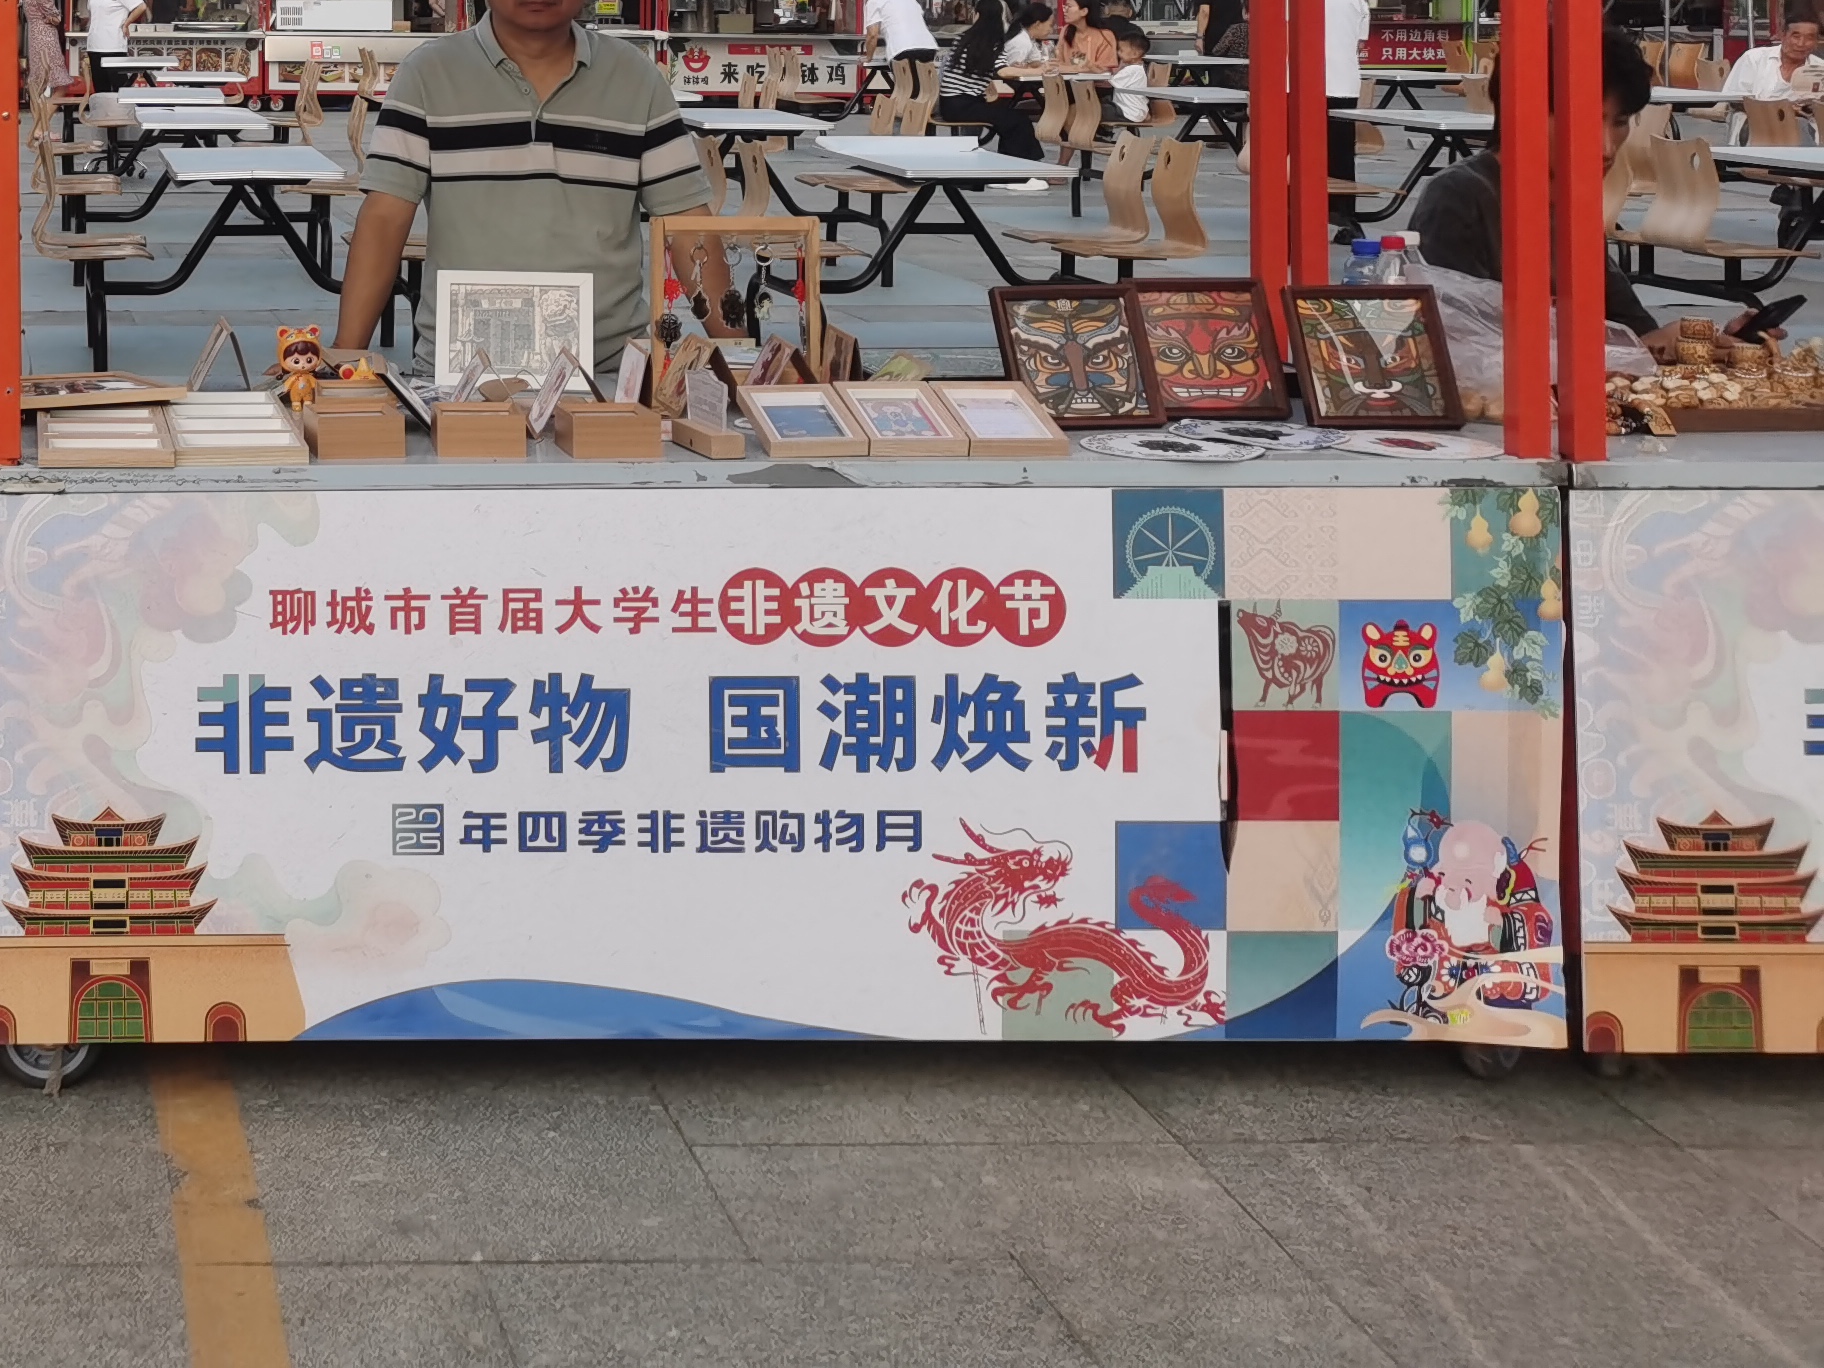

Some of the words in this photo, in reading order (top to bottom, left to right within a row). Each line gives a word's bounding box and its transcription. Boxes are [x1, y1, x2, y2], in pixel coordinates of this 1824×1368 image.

[1380, 29, 1450, 43] 不用边角料
[720, 62, 846, 86] 来吃钵鸡
[194, 672, 632, 775] 非遗好物
[708, 671, 1148, 774] 国潮焕新
